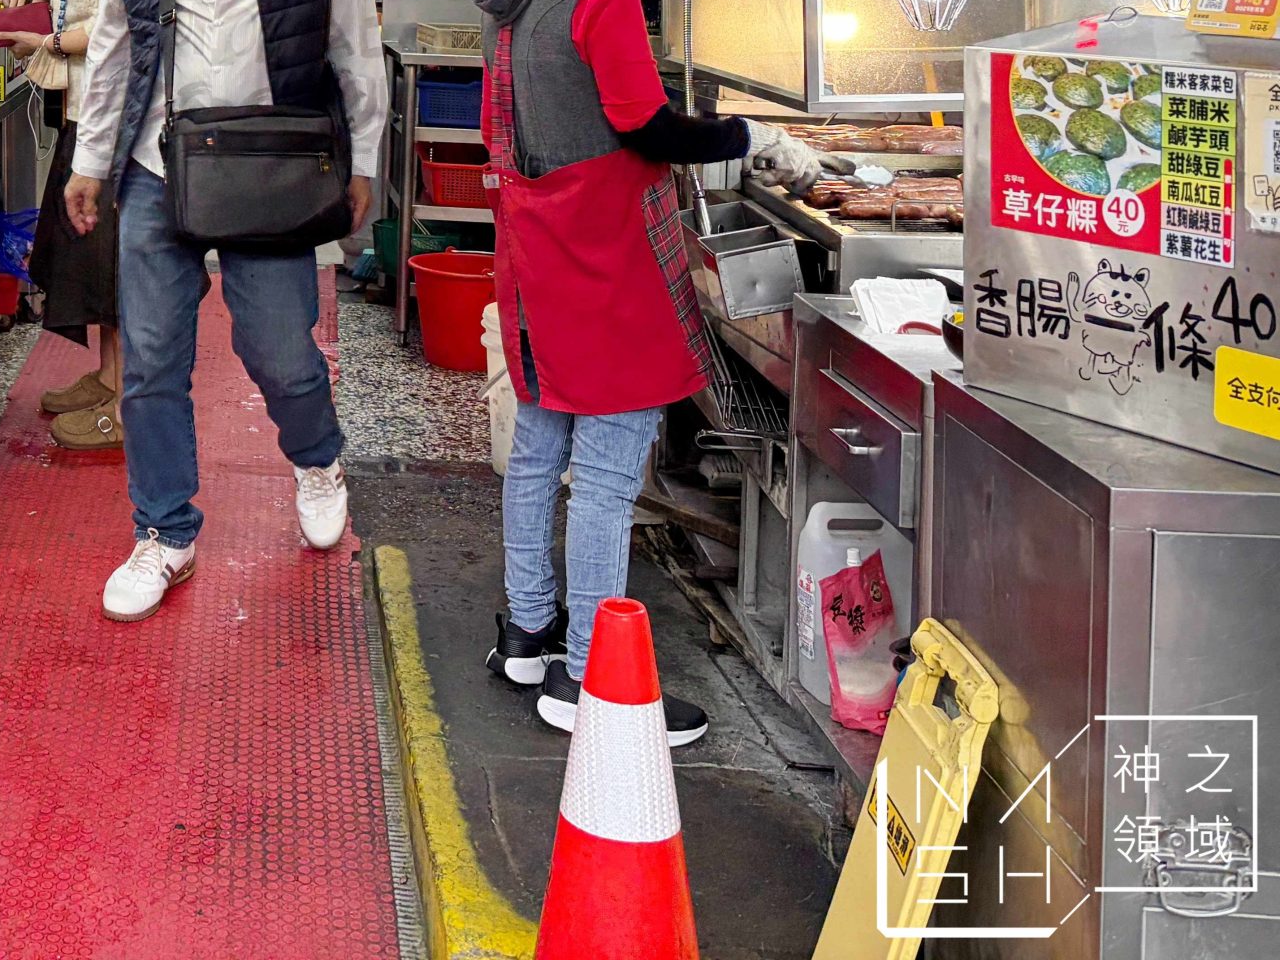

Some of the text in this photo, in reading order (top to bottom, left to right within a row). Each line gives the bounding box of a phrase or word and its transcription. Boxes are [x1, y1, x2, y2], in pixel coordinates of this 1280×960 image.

[1164, 70, 1234, 94] 糯米客家菜包
[1168, 96, 1230, 123] 菜脯米
[1167, 123, 1229, 152] 鹹芋頭
[1004, 174, 1025, 184] 古早味
[1167, 152, 1220, 179] 甜綠豆
[1167, 180, 1221, 207] 南瓜紅豆
[1002, 188, 1098, 235] 草仔粿
[1107, 196, 1139, 222] 40
[1118, 221, 1129, 233] 元
[1165, 233, 1221, 262] 紫薯花生
